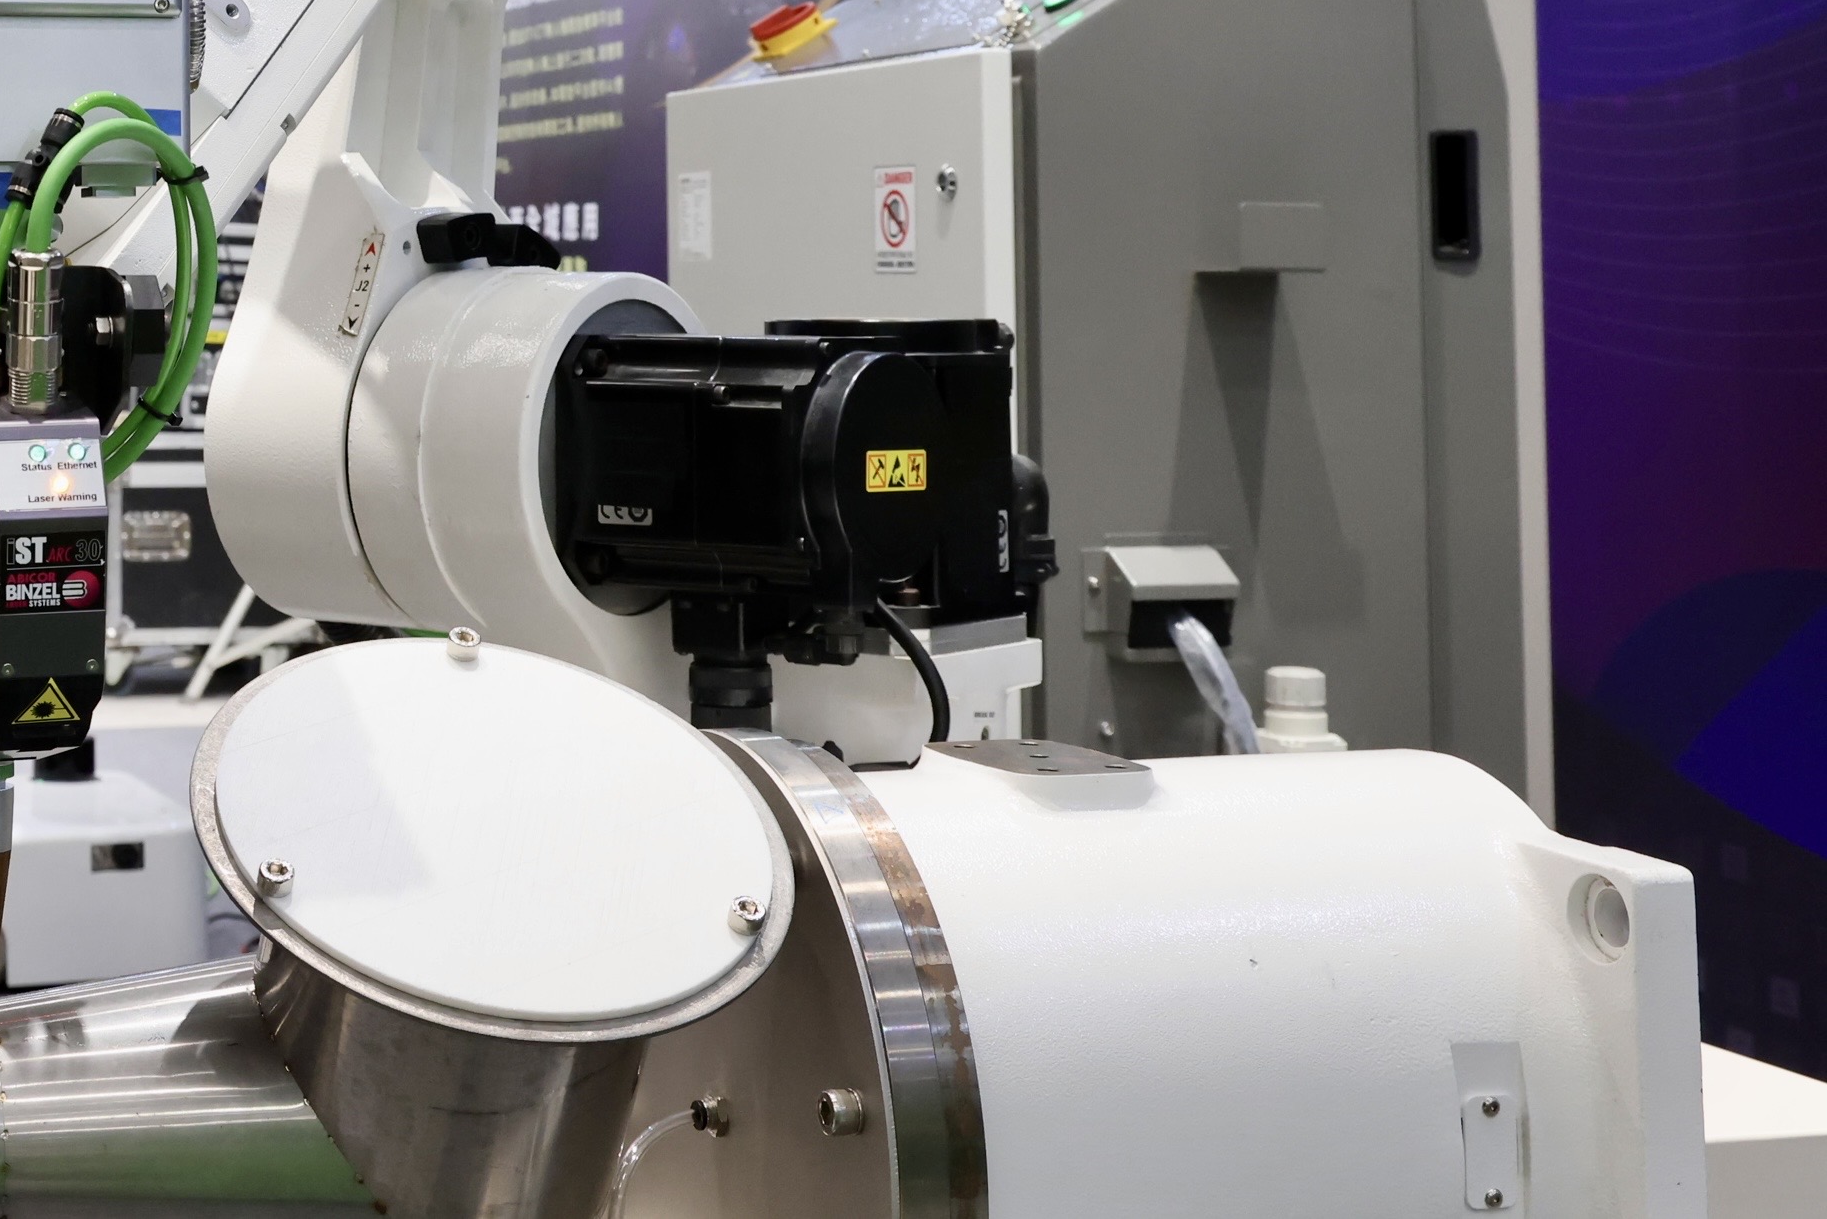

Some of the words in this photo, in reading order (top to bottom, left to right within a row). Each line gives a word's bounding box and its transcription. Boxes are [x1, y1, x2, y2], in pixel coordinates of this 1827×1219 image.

[355, 280, 370, 292] J2
[21, 463, 52, 472] Status
[57, 461, 97, 470] Ethernet
[28, 494, 54, 503] Laser
[58, 493, 97, 503] Warning
[75, 538, 102, 562] 30
[8, 572, 55, 583] ABICOR
[6, 582, 61, 601] BINZEL
[29, 599, 61, 607] SYSTEMS
